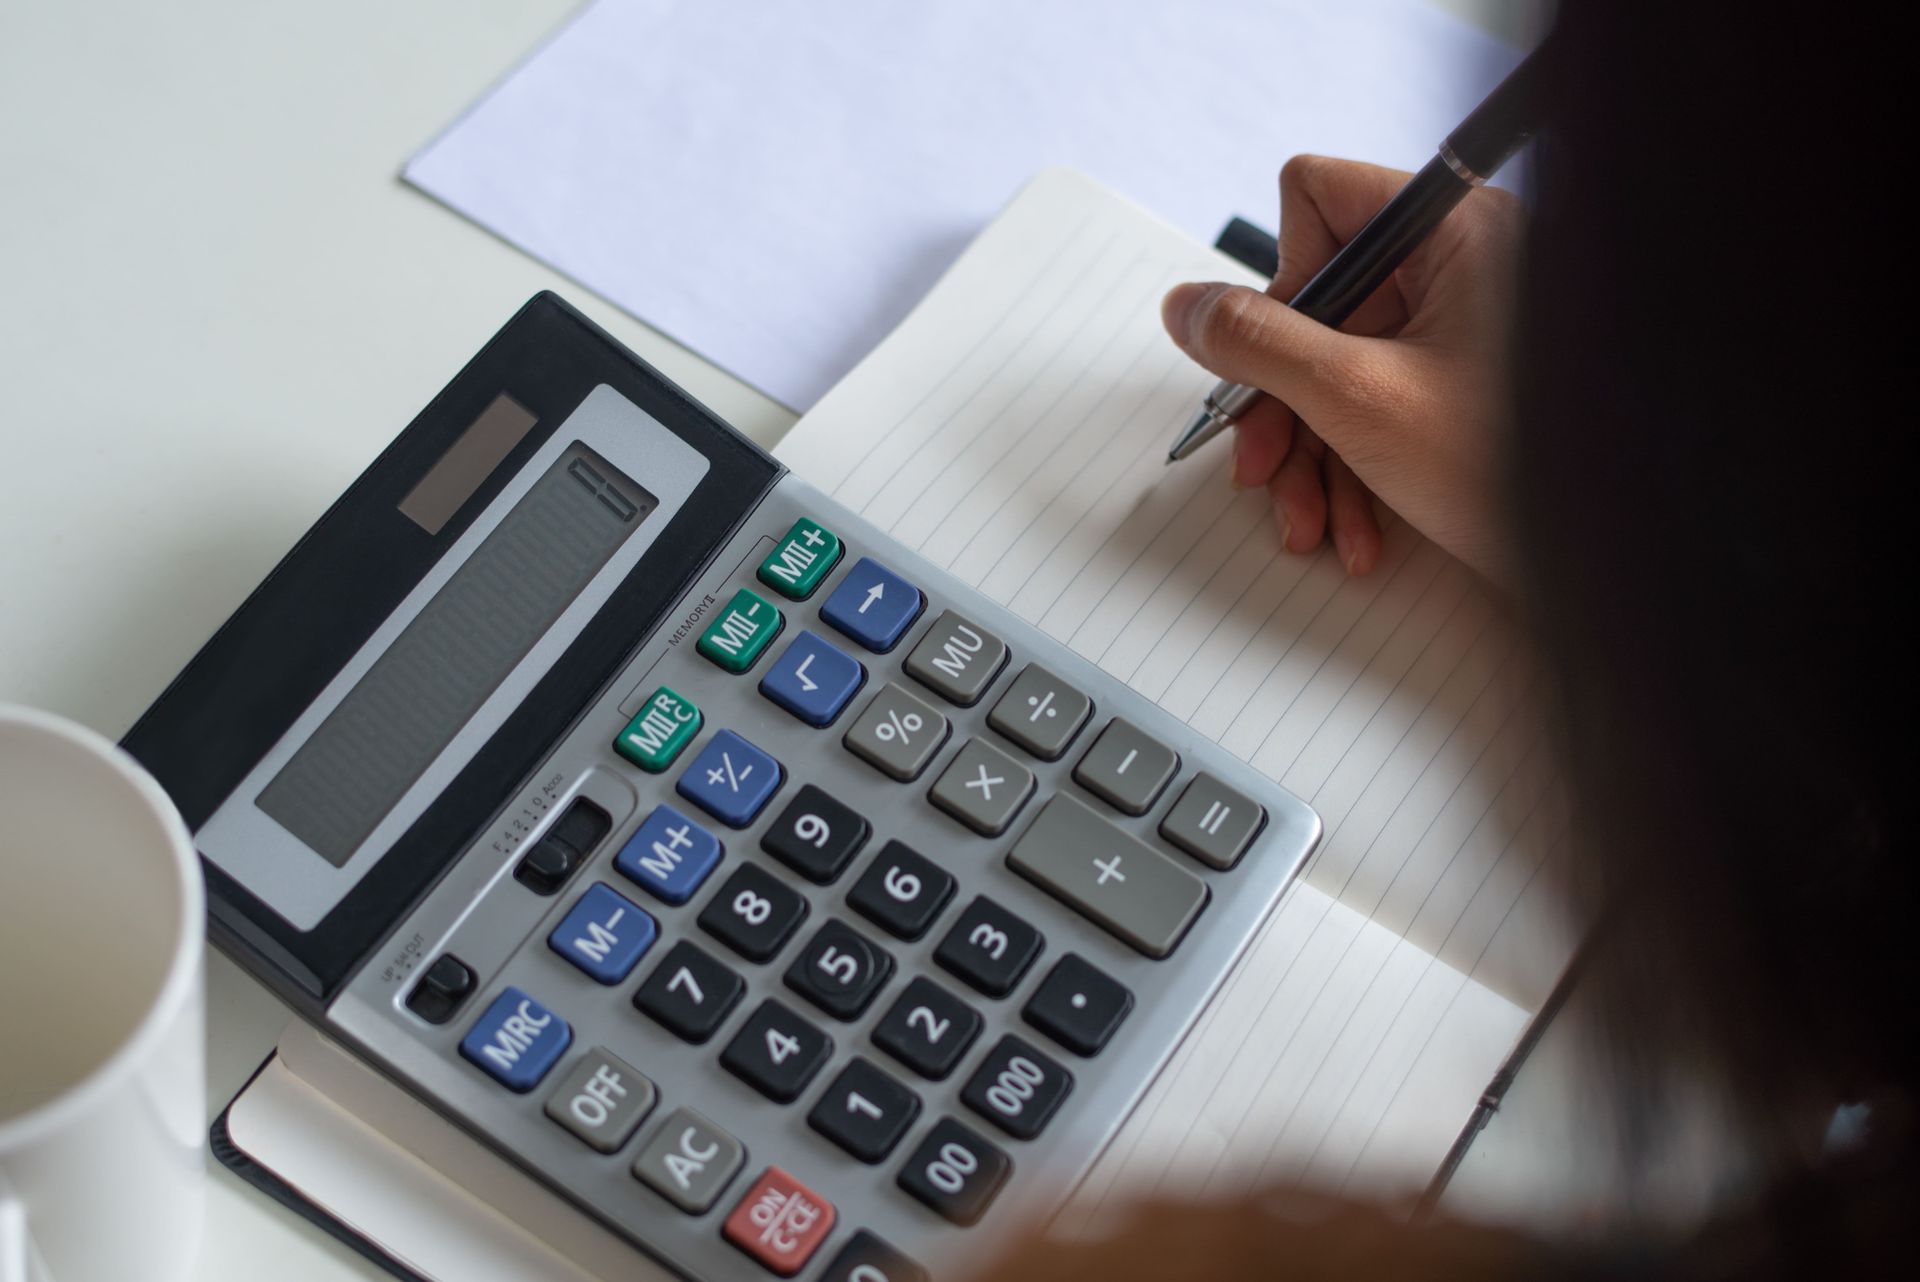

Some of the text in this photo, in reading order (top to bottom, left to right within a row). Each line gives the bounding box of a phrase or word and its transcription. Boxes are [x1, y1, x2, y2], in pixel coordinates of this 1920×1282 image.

[932, 625, 983, 677] MU
[513, 819, 523, 829] 2
[794, 813, 830, 848] 9
[639, 825, 693, 880] M+
[884, 866, 921, 901] 6
[733, 890, 772, 925] 8
[574, 908, 625, 962] M-
[969, 923, 1008, 960] 3
[817, 946, 858, 984] 5
[667, 967, 704, 1004] 7
[482, 999, 551, 1070] MRC
[907, 1006, 950, 1043] 2
[765, 1028, 800, 1064] 4
[570, 1064, 627, 1127] OFF
[986, 1056, 1045, 1116] 000
[847, 1092, 883, 1119] 1
[663, 1127, 718, 1189] AC
[926, 1142, 978, 1193] 00
[750, 1187, 787, 1227] ON
